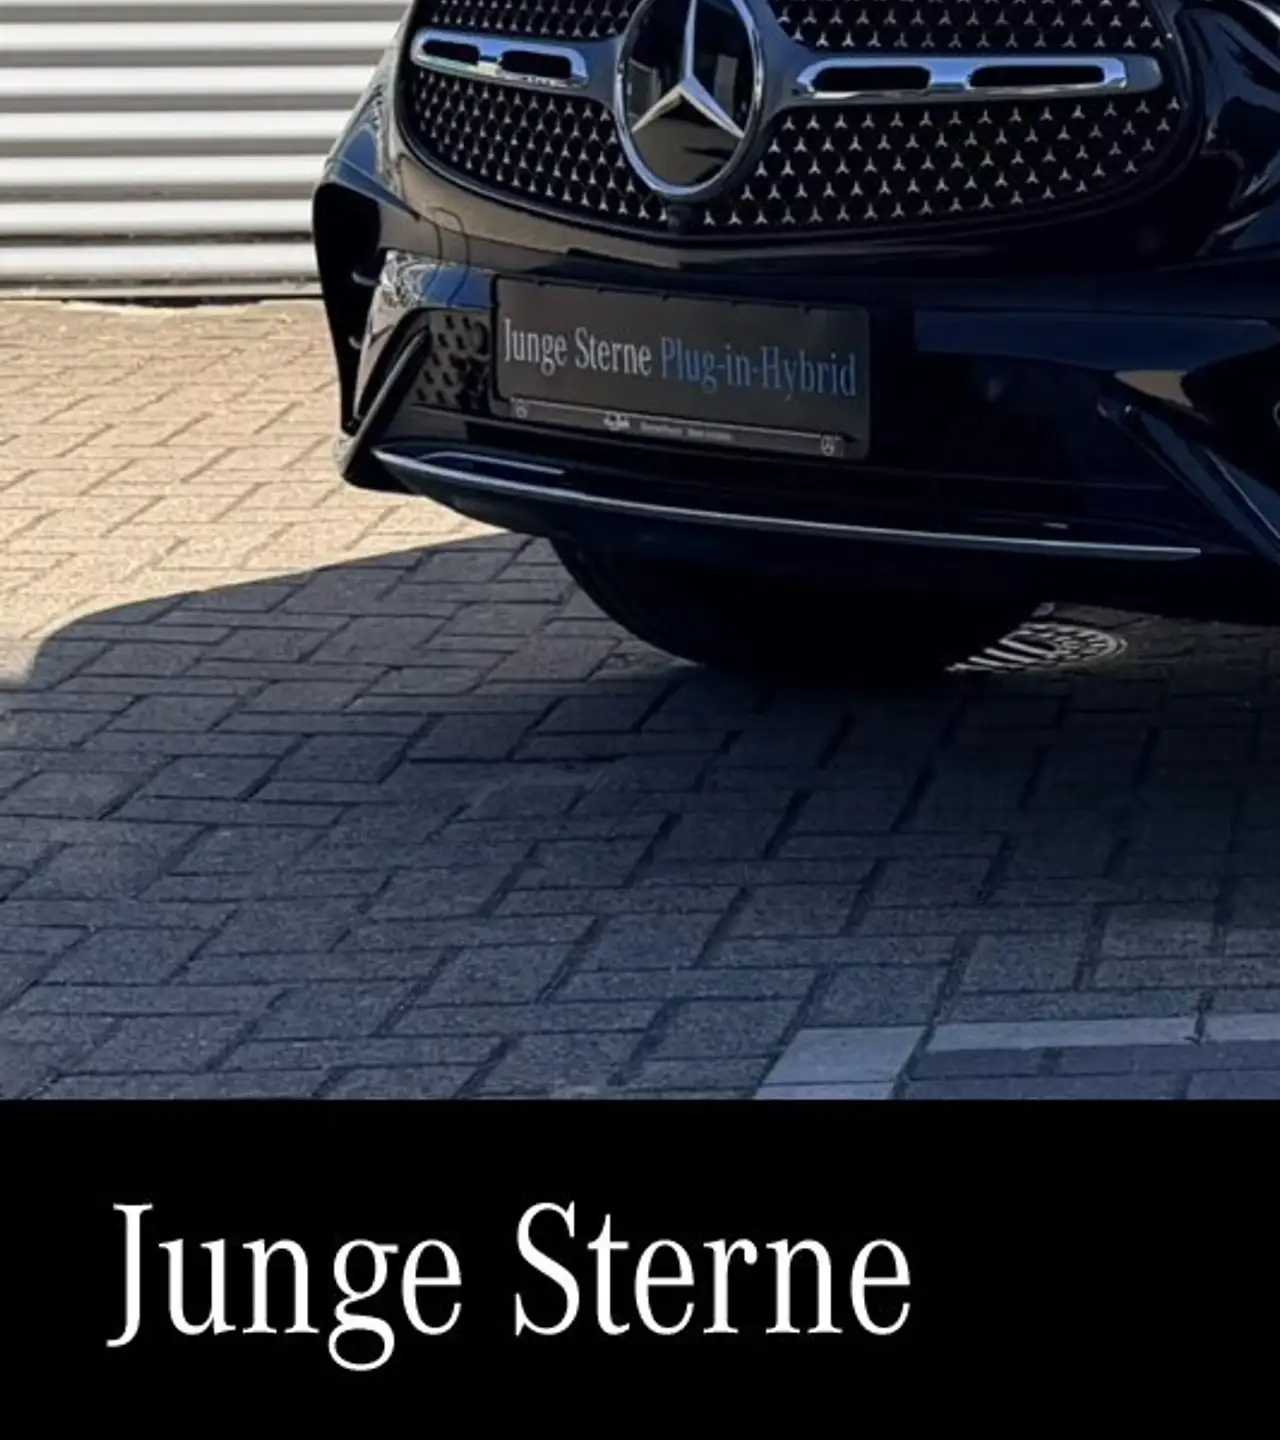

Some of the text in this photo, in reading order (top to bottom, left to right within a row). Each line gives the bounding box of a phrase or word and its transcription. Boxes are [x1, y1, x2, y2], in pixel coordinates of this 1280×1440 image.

[504, 318, 857, 401] Junge Sterne Plug-in-Hybrid
